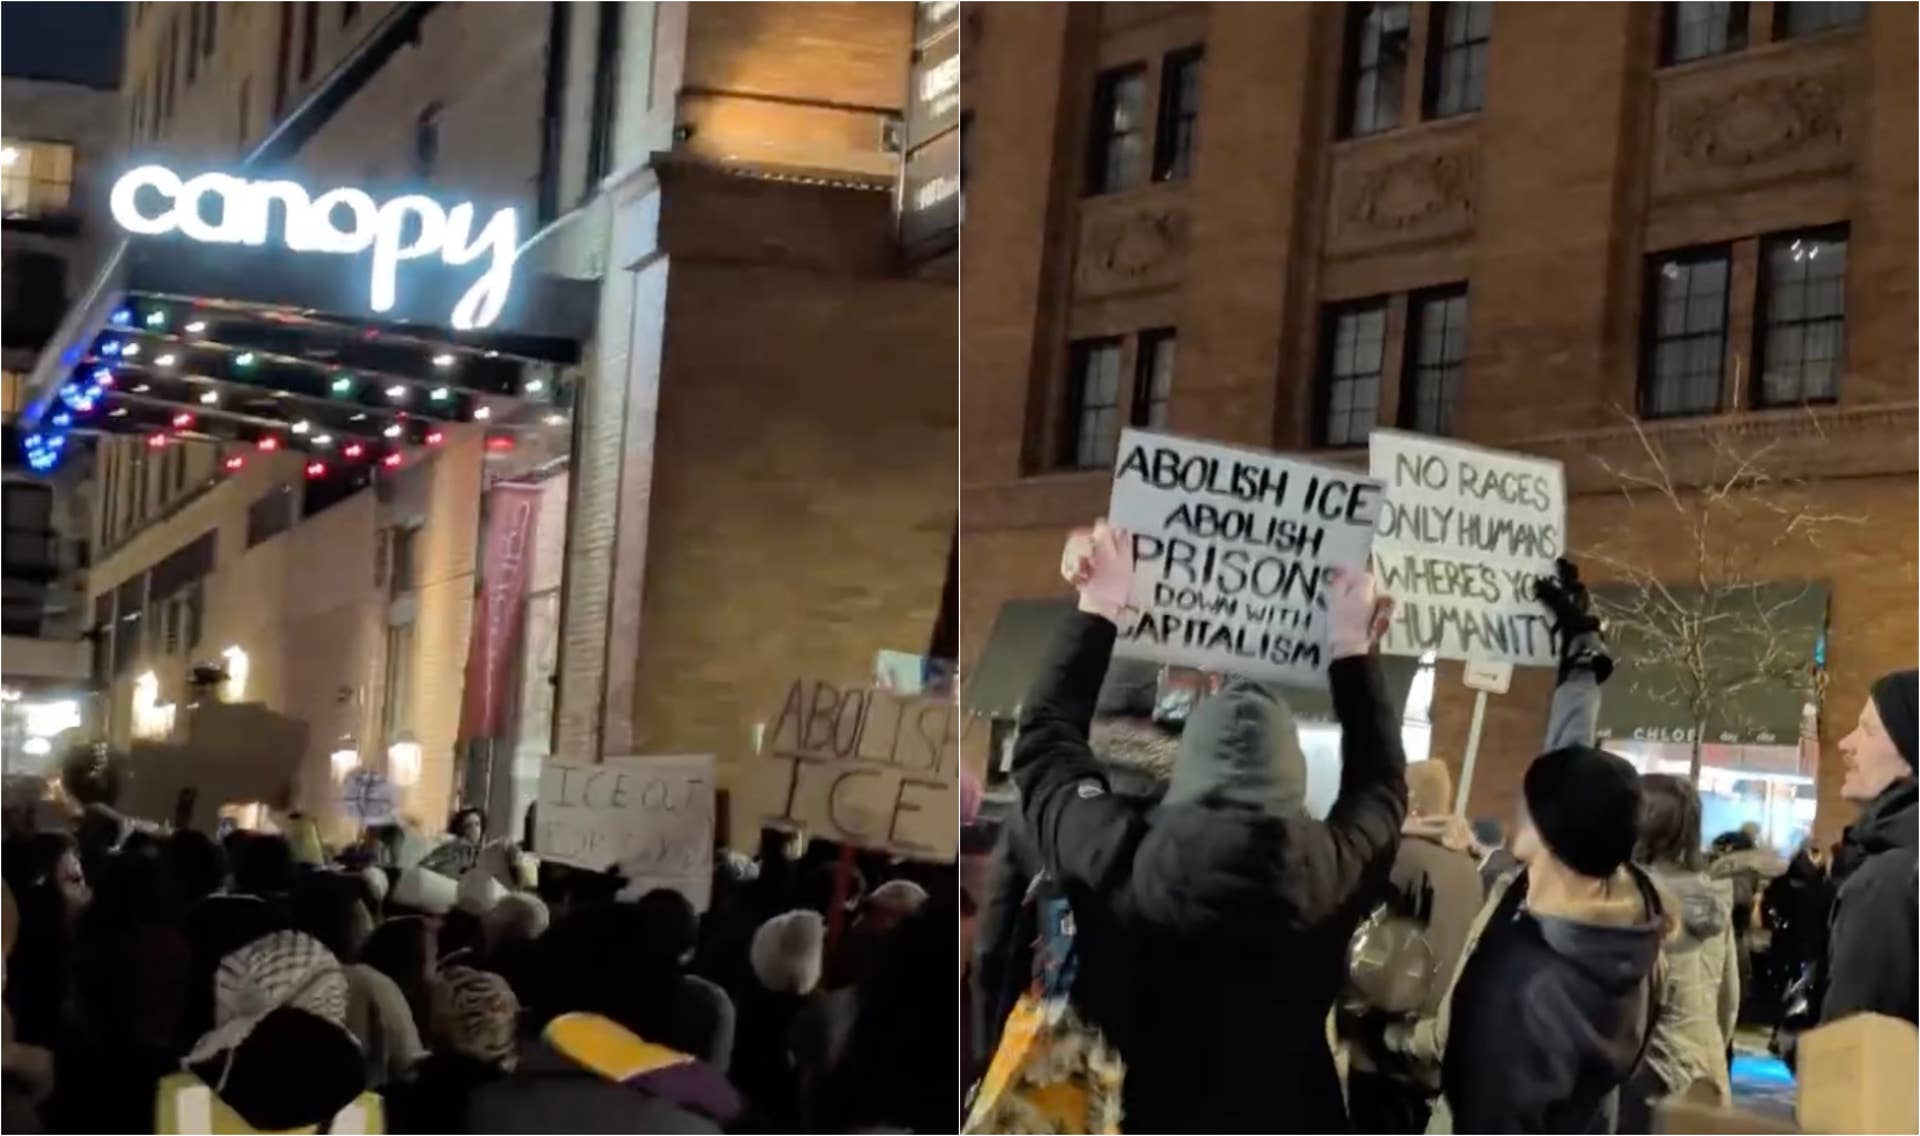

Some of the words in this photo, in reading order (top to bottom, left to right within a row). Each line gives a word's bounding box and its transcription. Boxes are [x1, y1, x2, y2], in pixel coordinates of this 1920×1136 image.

[110, 165, 517, 330] canopy
[1117, 445, 1289, 508] ABOLISH
[1303, 477, 1382, 527] ICE
[1396, 452, 1448, 490] NO
[1459, 462, 1550, 512] RACES
[1163, 502, 1324, 558] ABOLISH
[1376, 499, 1453, 543] ONLY
[1459, 511, 1558, 560] HUMANS
[1154, 583, 1238, 616] DOWN
[1246, 603, 1312, 630] WITH
[1376, 555, 1500, 603] WHERE'S
[1388, 600, 1560, 657] HUMANITY
[550, 766, 629, 808] ICE
[764, 751, 949, 851] ICE
